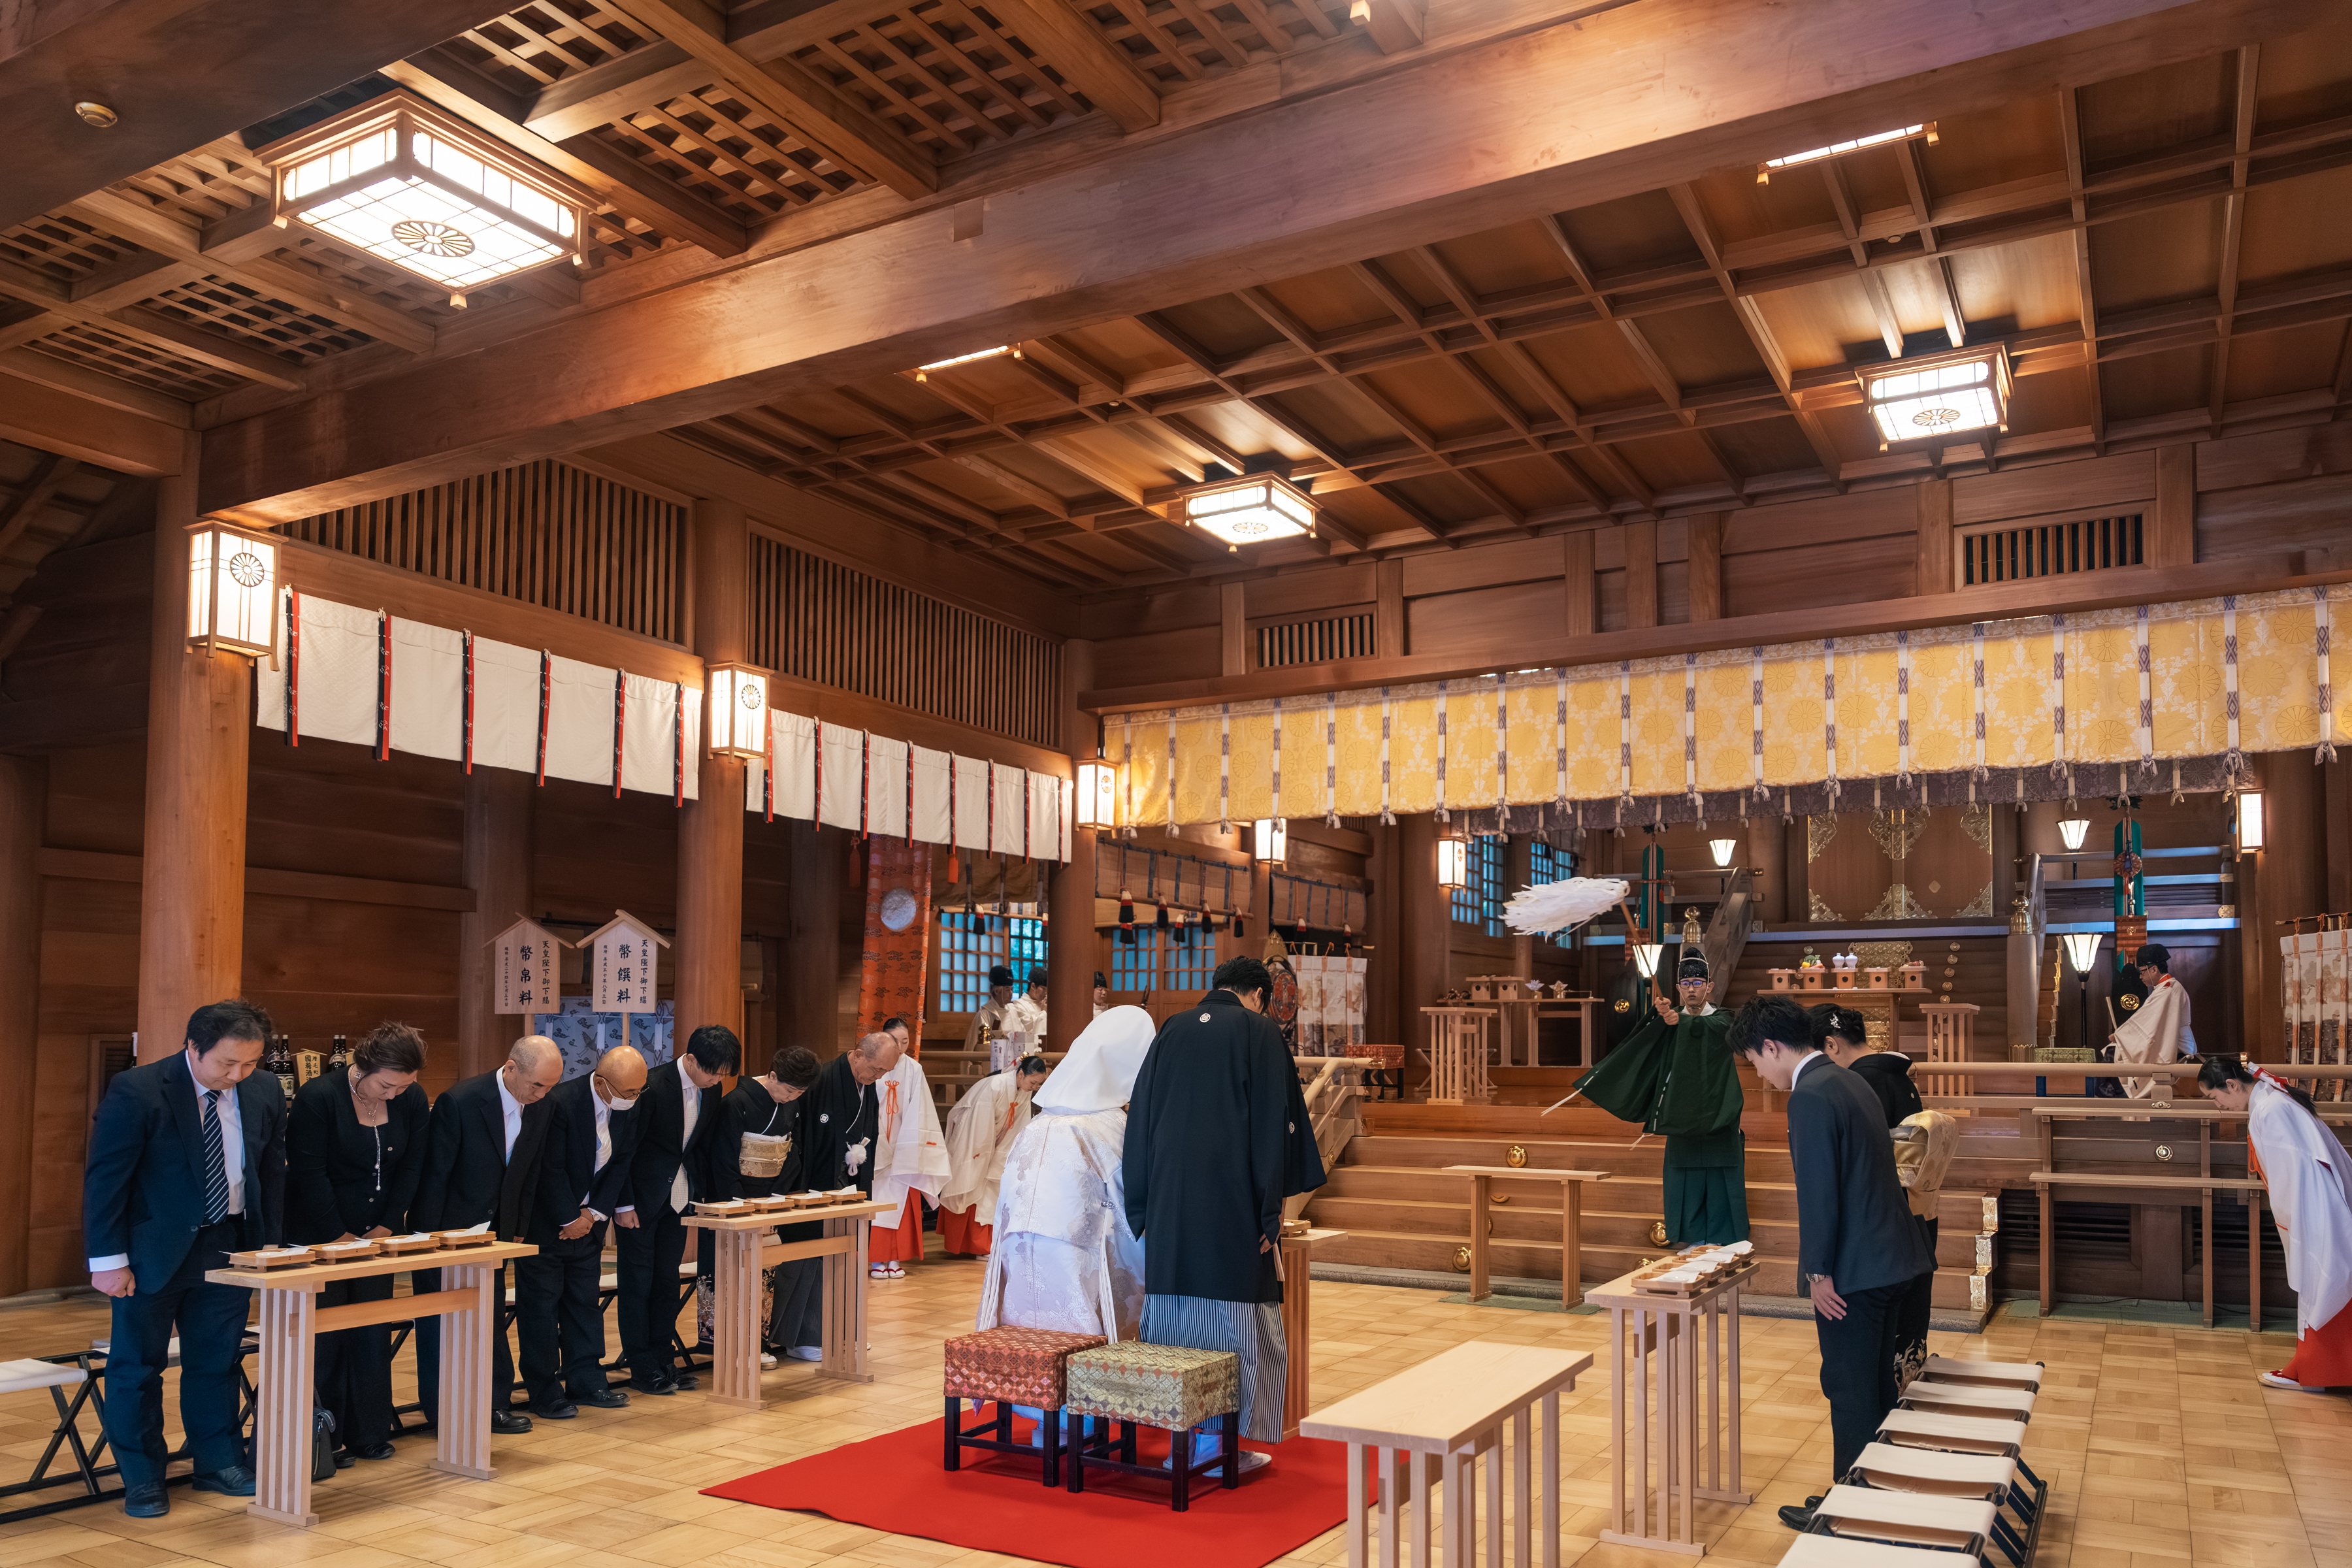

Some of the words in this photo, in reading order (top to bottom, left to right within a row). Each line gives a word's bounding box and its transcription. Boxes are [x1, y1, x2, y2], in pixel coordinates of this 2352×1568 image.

[542, 940, 550, 1005] 天皇陛下御下賜
[640, 939, 648, 1004] 天皇陛下御下賜
